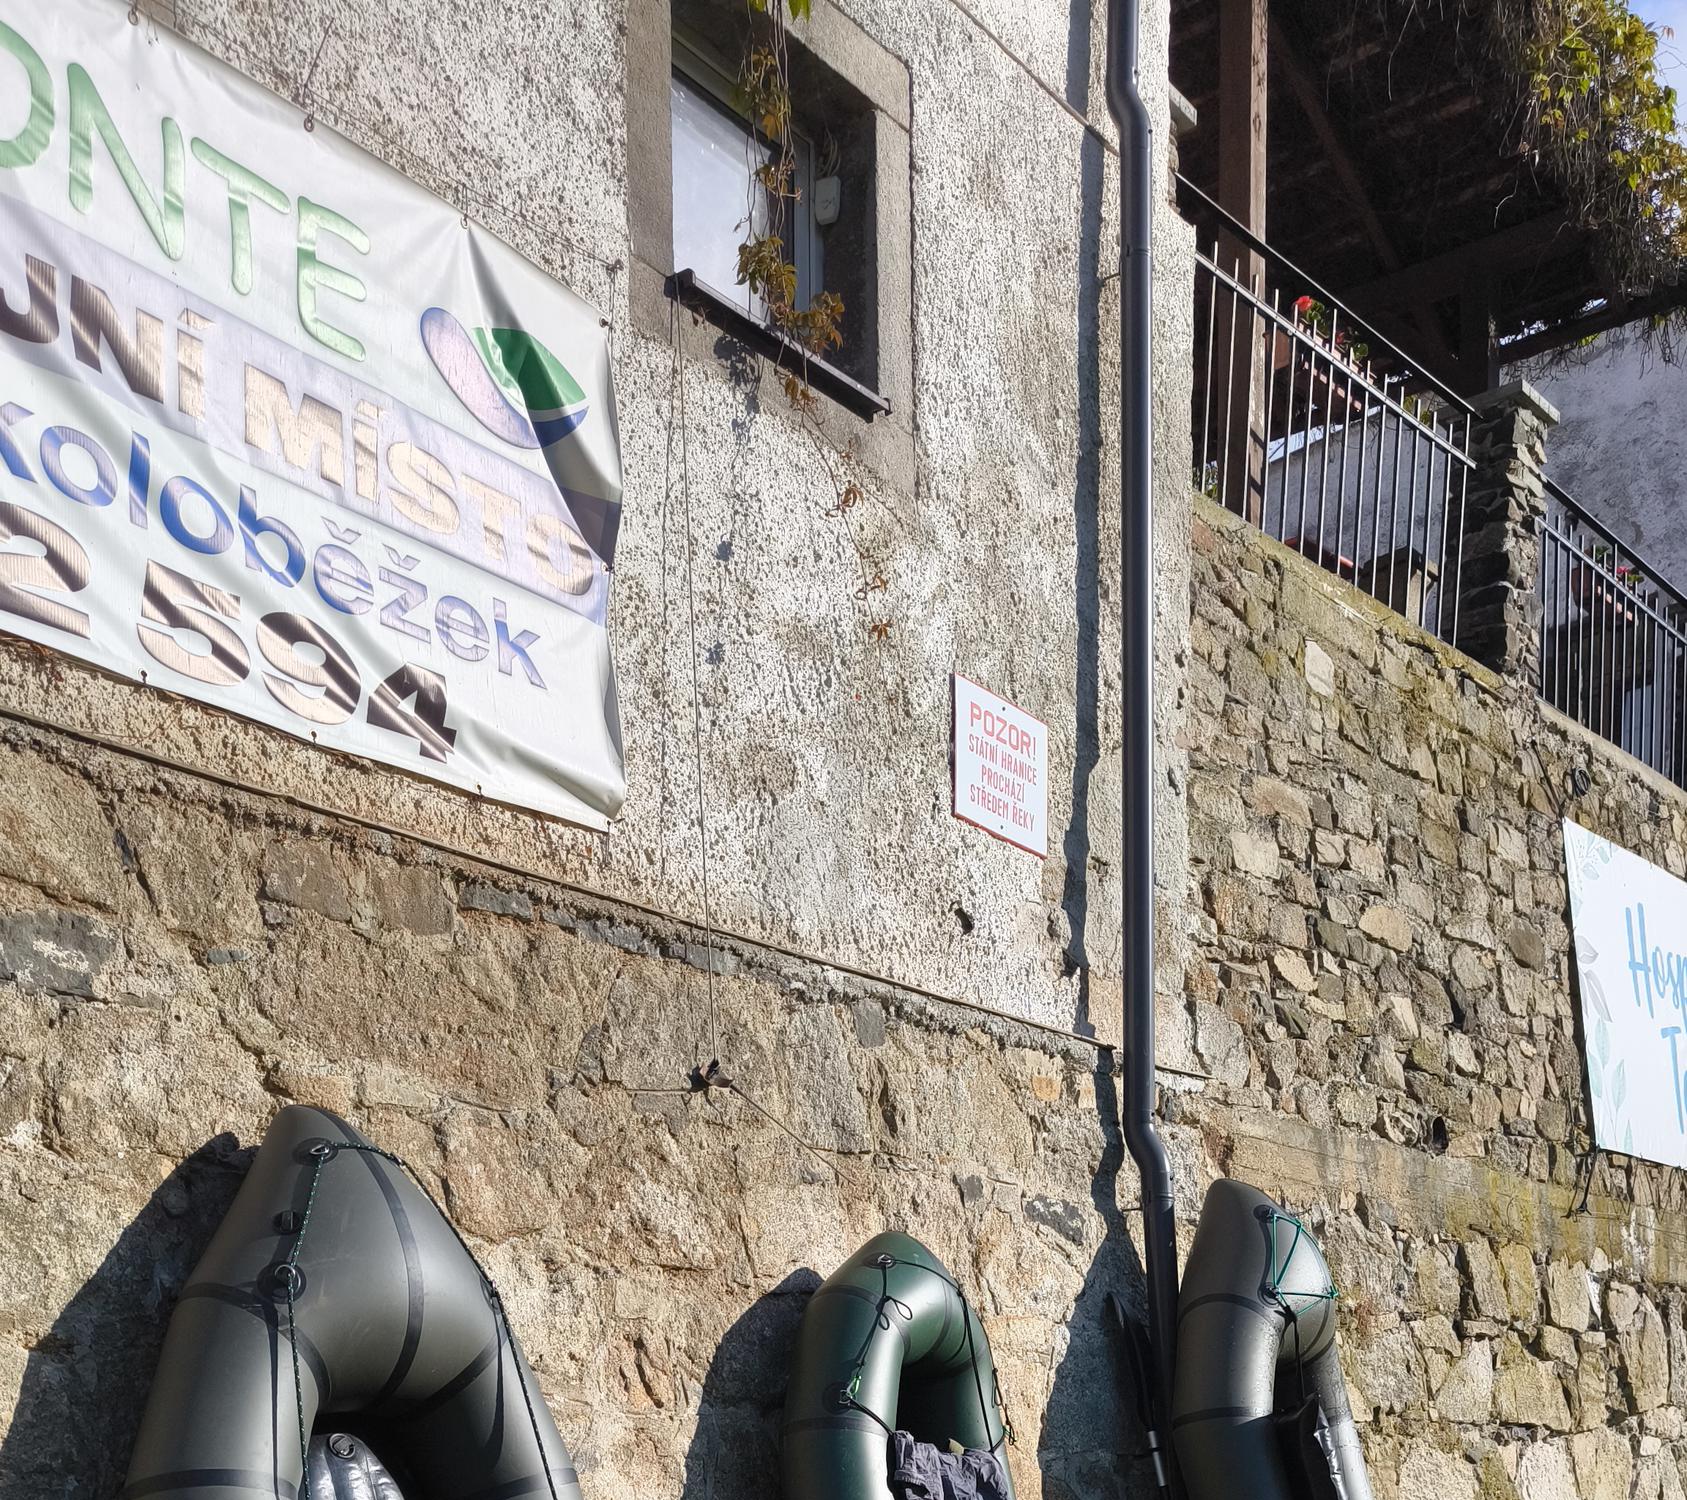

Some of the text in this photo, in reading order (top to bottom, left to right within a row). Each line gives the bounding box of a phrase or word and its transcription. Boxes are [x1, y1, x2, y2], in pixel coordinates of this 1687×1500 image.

[244, 362, 594, 596] MÍSTO
[137, 559, 457, 763] 594
[970, 701, 1036, 761] POZOR!
[969, 734, 1037, 786] STÁTNÍ HRANICE
[981, 765, 1025, 803] PROCHÁZÍ
[970, 784, 1035, 832] STŘEDEM ŘEKY
